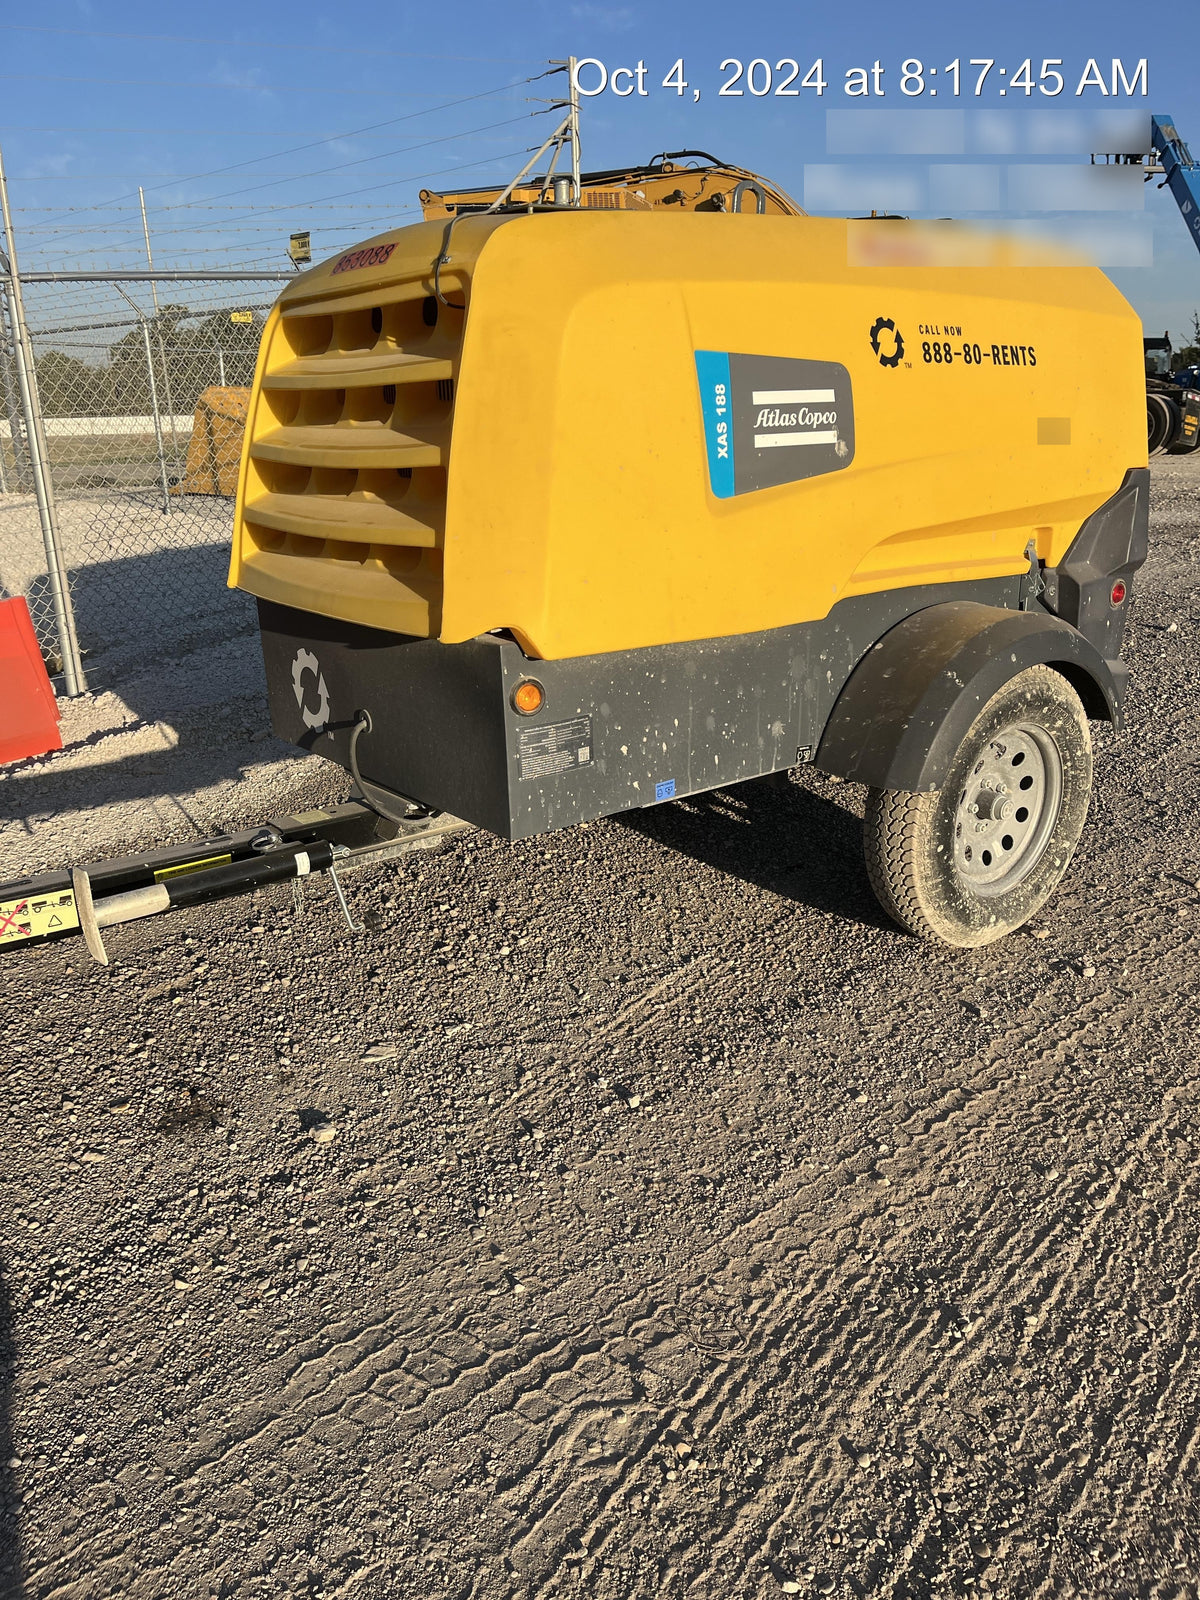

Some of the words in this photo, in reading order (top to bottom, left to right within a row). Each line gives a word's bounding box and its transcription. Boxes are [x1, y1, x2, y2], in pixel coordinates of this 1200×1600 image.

[918, 324, 941, 335] CALL
[943, 325, 962, 336] NOW
[921, 341, 1037, 367] 888-80-RENTS
[714, 383, 727, 416] 188
[753, 408, 798, 428] Atlas
[798, 407, 838, 429] Copco
[716, 421, 729, 459] XAS
